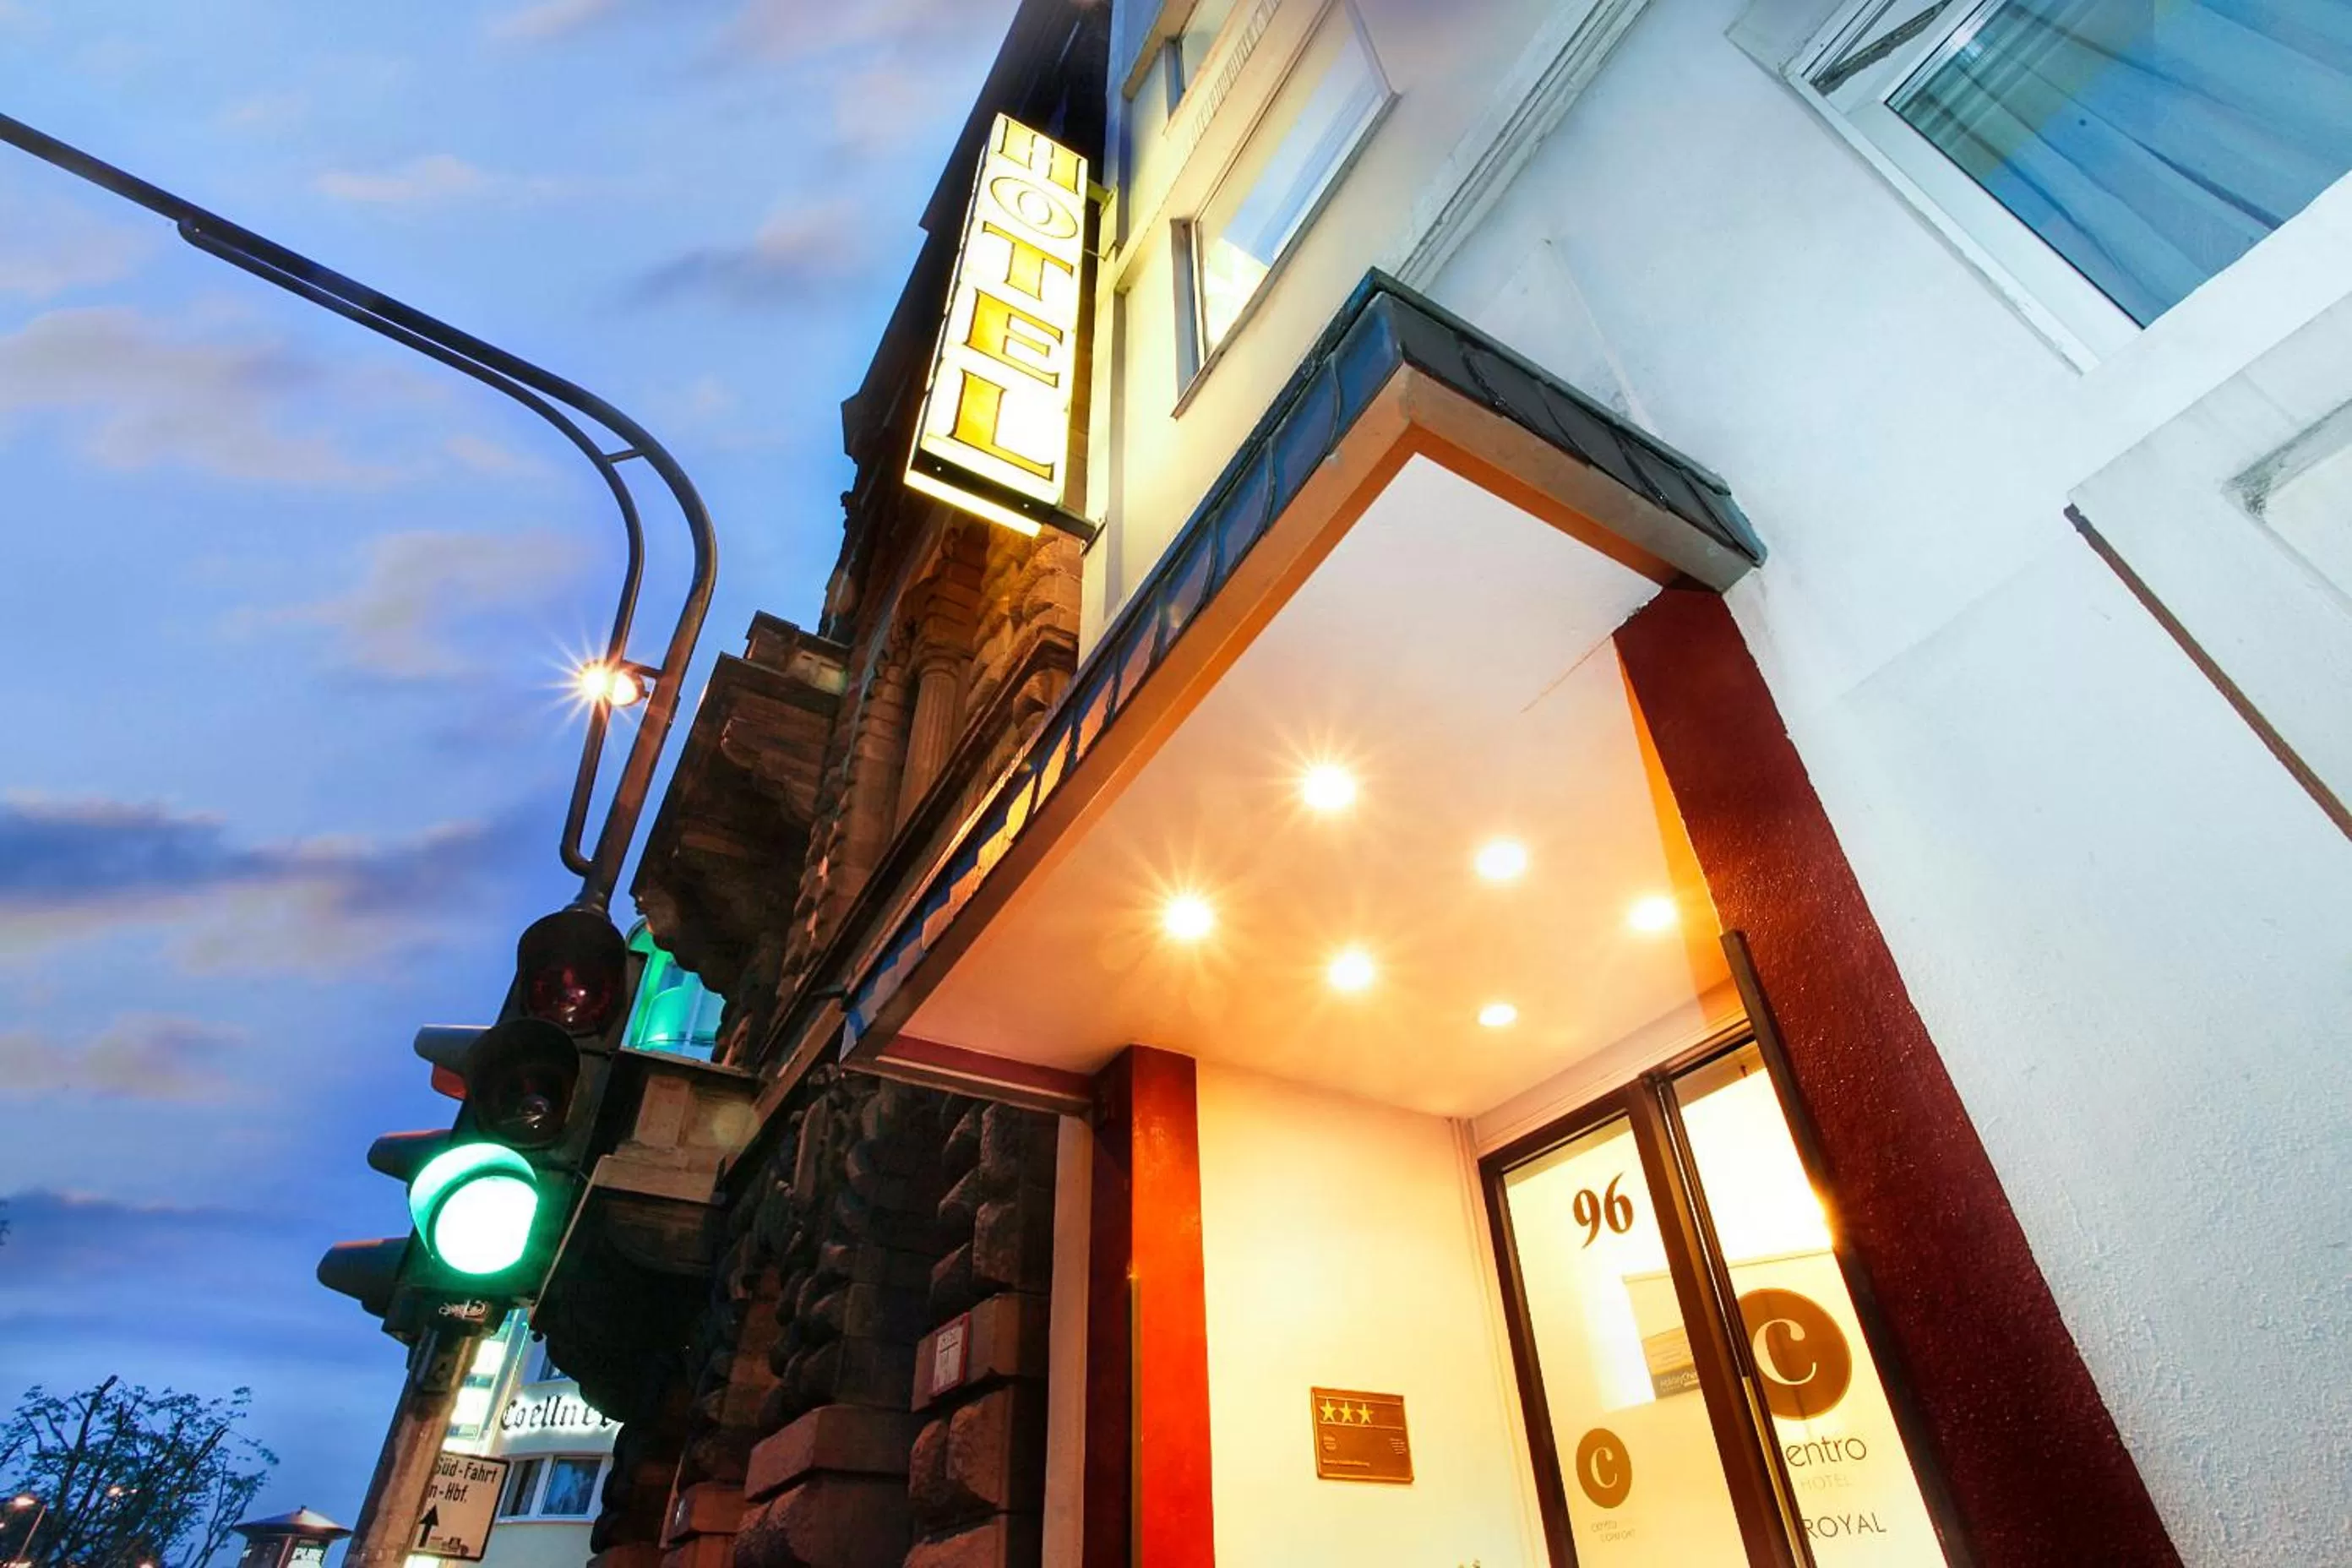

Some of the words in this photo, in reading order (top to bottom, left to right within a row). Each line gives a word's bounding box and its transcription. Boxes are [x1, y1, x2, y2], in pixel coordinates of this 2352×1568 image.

[948, 117, 1081, 482] HOTEL
[1573, 1171, 1633, 1250] 96
[1785, 1436, 1867, 1467] entro
[1802, 1512, 1887, 1538] ROYAL
